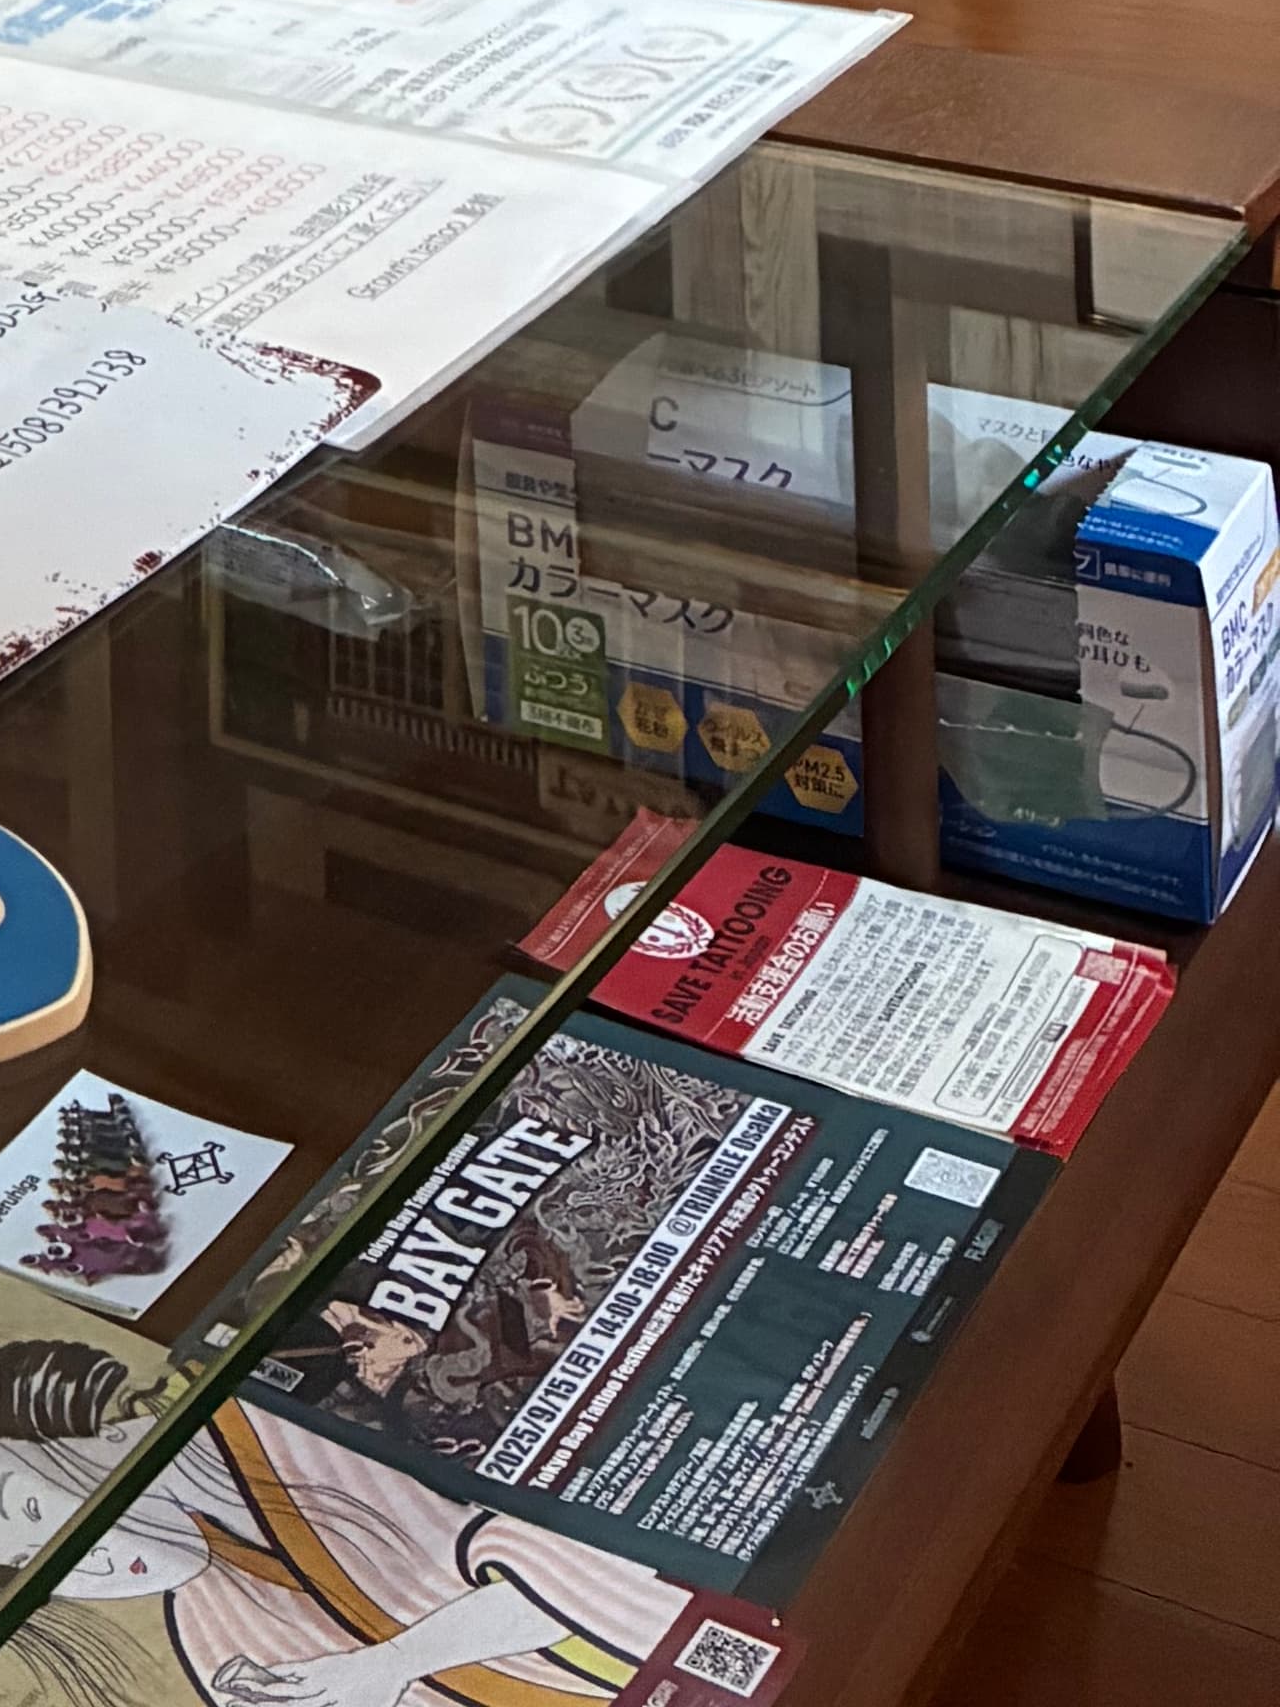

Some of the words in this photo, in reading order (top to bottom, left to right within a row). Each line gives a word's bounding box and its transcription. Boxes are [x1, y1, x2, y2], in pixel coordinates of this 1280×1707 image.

[18, 199, 111, 248] ¥40000
[60, 208, 153, 257] ¥45000
[101, 216, 195, 266] ¥50000
[143, 223, 237, 275] ¥55000
[511, 603, 564, 657] 10
[651, 967, 712, 1025] SAVE
[703, 865, 793, 973] TATTOOING
[724, 901, 836, 1028] 活動支援金のお願い
[359, 1225, 391, 1265] Tokyo
[387, 1201, 409, 1230] Bay
[403, 1166, 439, 1208] Tattoo
[433, 1133, 480, 1178] Festival
[369, 1217, 487, 1332] BAY
[434, 1116, 593, 1230] GATE
[588, 1240, 680, 1341] 14:00-18:00
[666, 1145, 751, 1238] @TRIANGLE
[733, 1103, 784, 1153] Osaka
[527, 1443, 572, 1489] Tokyo
[563, 1419, 589, 1451] Bay
[583, 1373, 623, 1421] Tattoo
